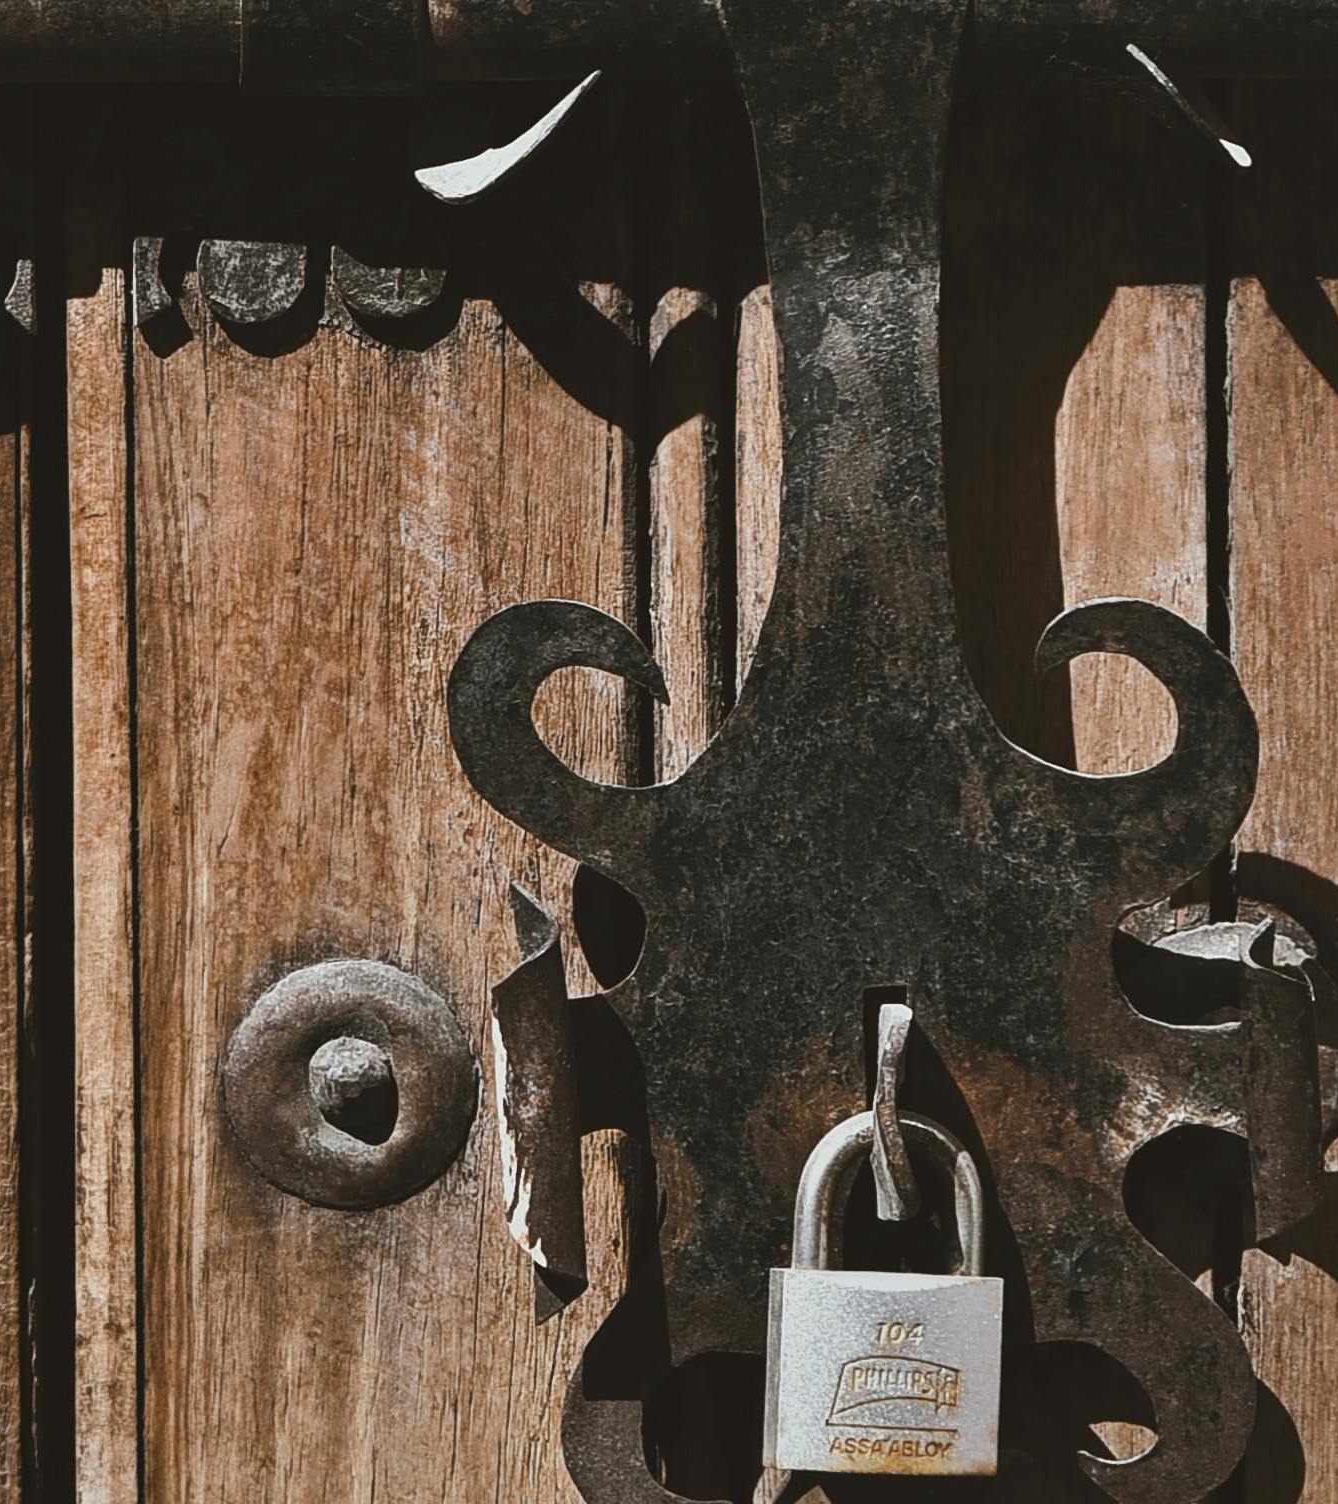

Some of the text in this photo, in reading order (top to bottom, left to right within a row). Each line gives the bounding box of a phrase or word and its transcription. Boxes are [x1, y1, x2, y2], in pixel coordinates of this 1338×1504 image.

[876, 1321, 924, 1345] 104
[852, 1367, 935, 1394] PHILLIPS
[829, 1437, 953, 1458] ASSA ABLOY
